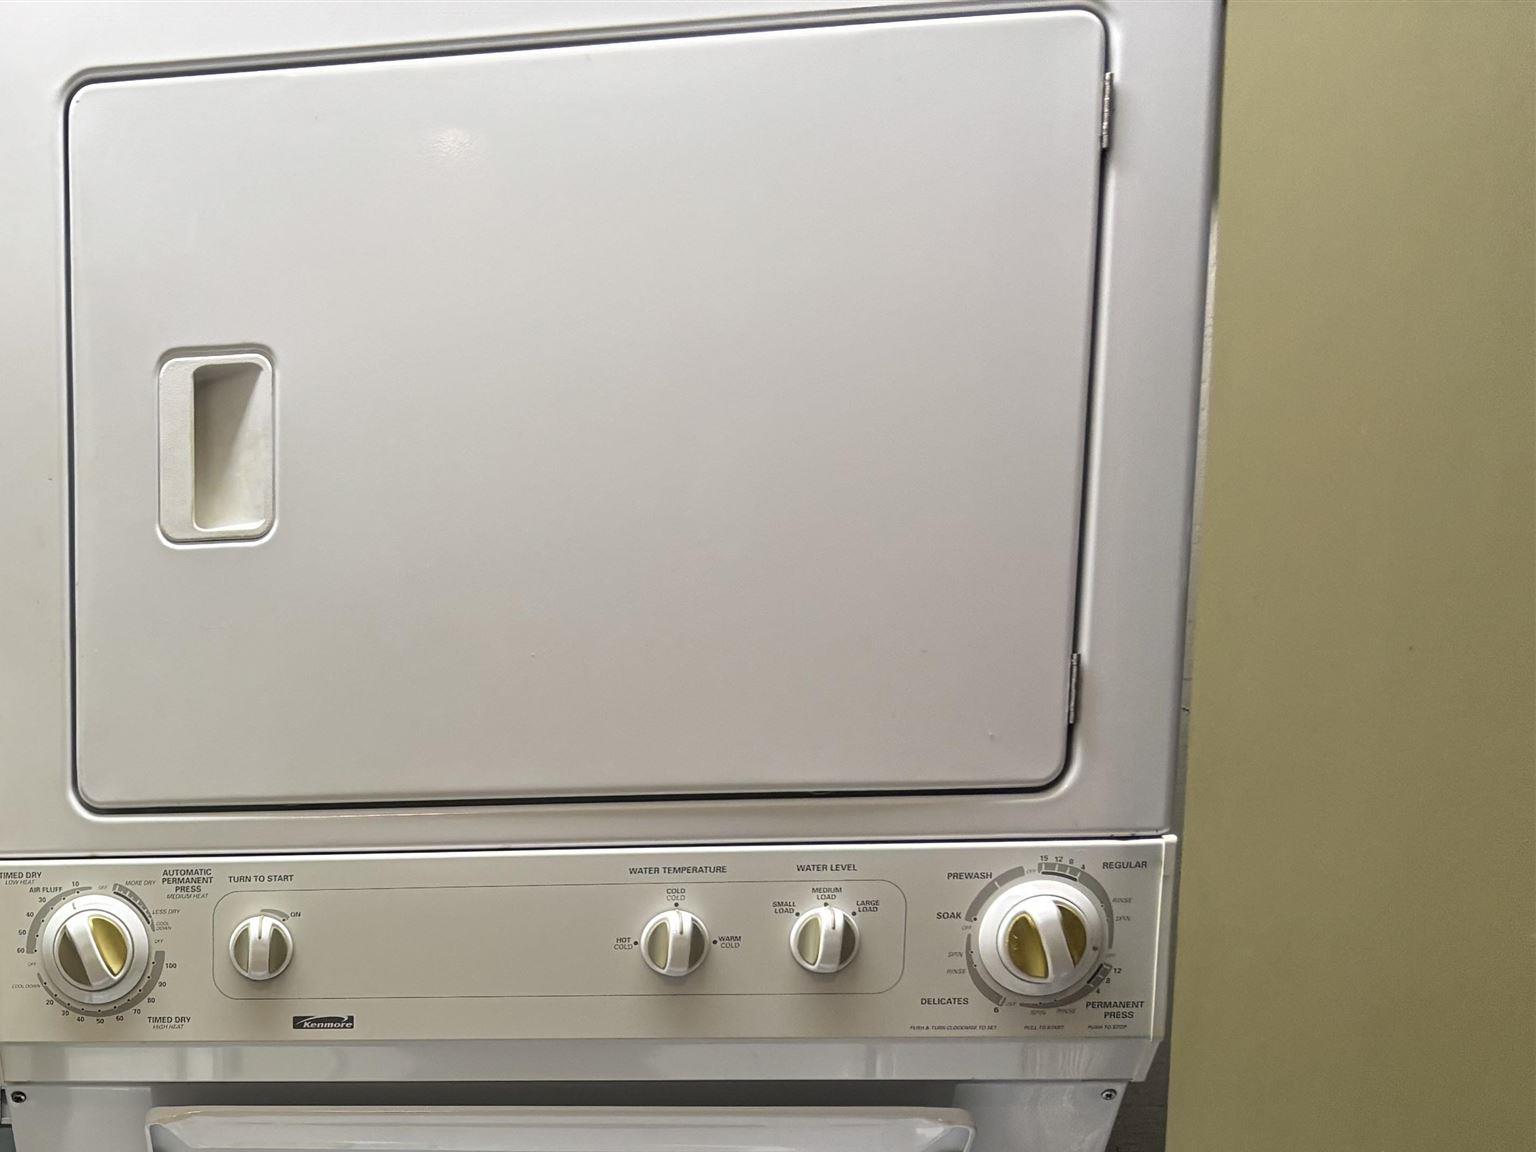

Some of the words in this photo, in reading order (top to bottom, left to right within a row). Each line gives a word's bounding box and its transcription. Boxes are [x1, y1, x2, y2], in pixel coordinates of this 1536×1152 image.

[796, 864, 828, 872] WATER
[830, 863, 858, 872] LEVEL
[1102, 860, 1147, 869] REGULAR
[162, 868, 212, 877] AUTOMATIC
[629, 867, 660, 875] WATER
[662, 865, 727, 874] TEMPERATURE
[25, 871, 42, 879] DRY
[228, 875, 252, 883] TURN
[254, 875, 265, 883] TO
[267, 874, 294, 882] START
[947, 871, 993, 880] PREWASH
[162, 877, 214, 885] PERMANENT
[175, 885, 202, 893] PRESS
[812, 886, 842, 894] MEDIUM
[856, 899, 880, 907] LARGE
[936, 911, 962, 919] SOAK
[920, 997, 969, 1005] DELICATES
[1085, 1001, 1144, 1009] PERMANENT
[1103, 1011, 1134, 1019] PRESS
[147, 1016, 172, 1024] TIMED
[173, 1016, 191, 1024] DRY
